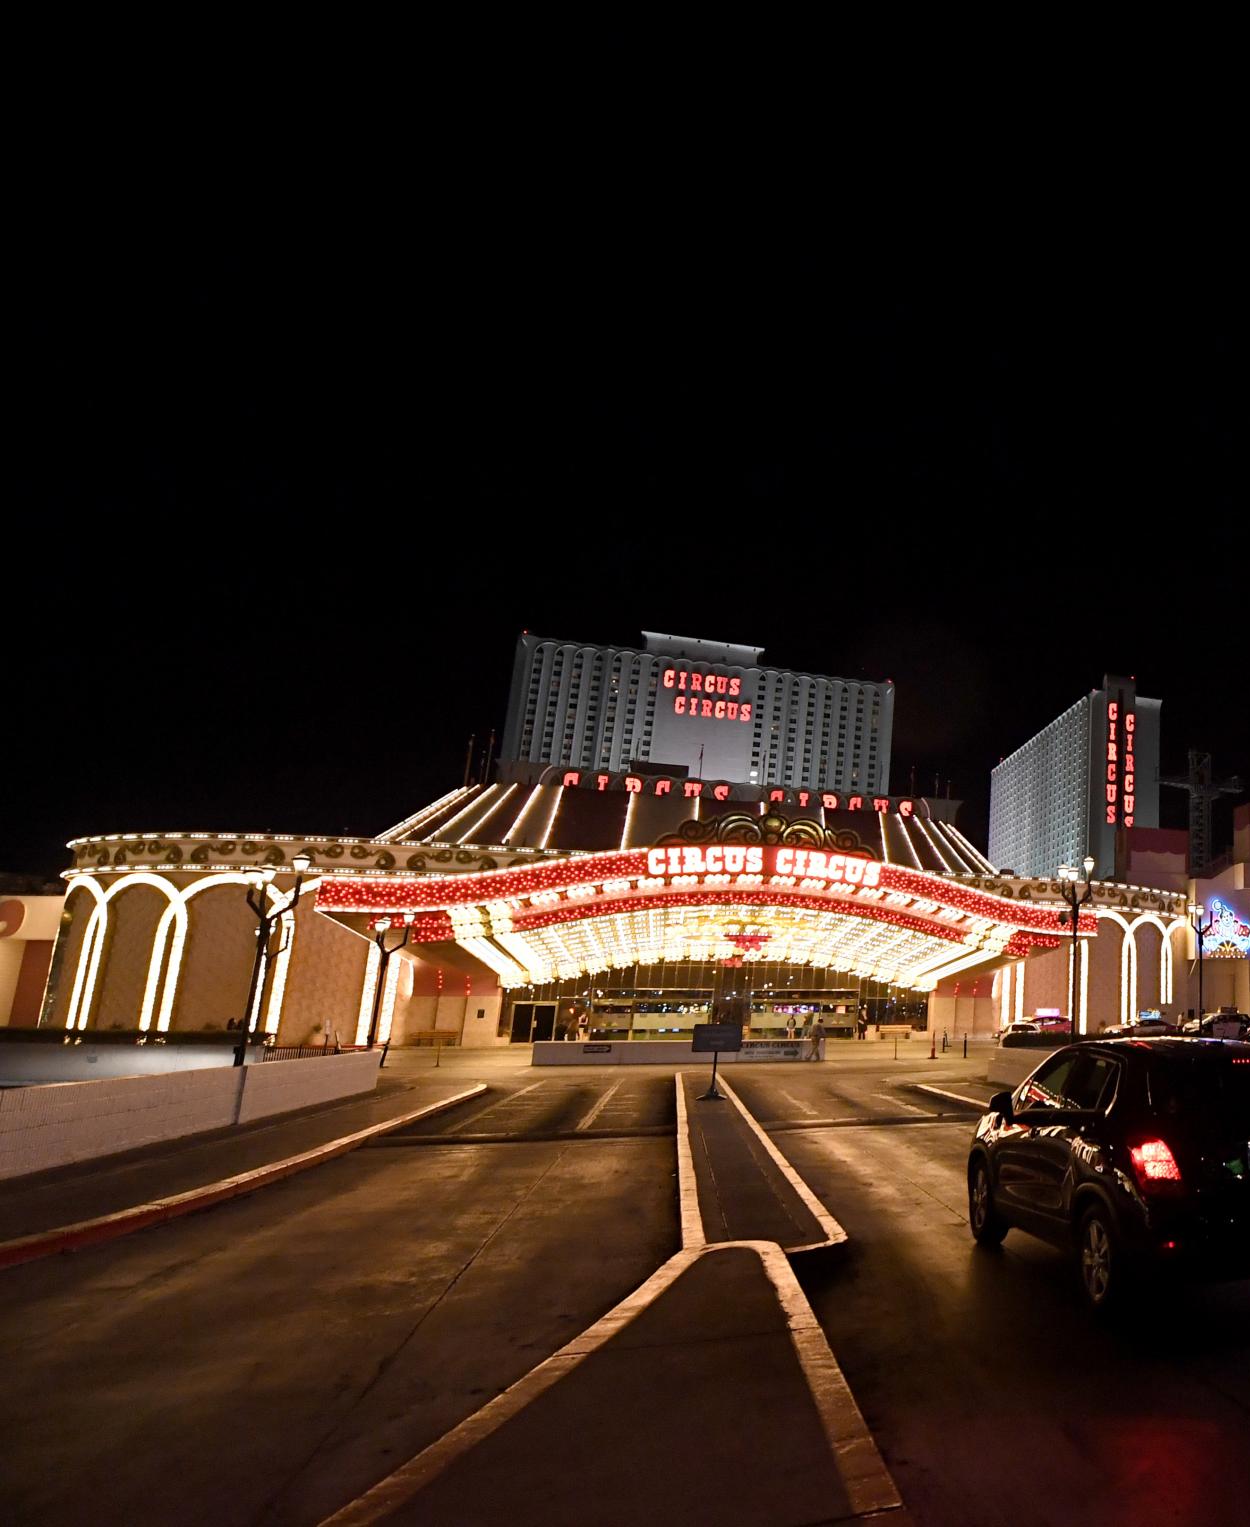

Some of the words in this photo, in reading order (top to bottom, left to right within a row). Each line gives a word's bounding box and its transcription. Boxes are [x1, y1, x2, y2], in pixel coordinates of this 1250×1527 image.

[663, 669, 741, 696] CIRCUS
[674, 696, 752, 722] CIRCUS
[1106, 702, 1118, 824] CIRCUS
[1123, 714, 1135, 827] CIRCUS
[648, 846, 763, 875] CIRCUS
[776, 849, 881, 886] CIRCUS
